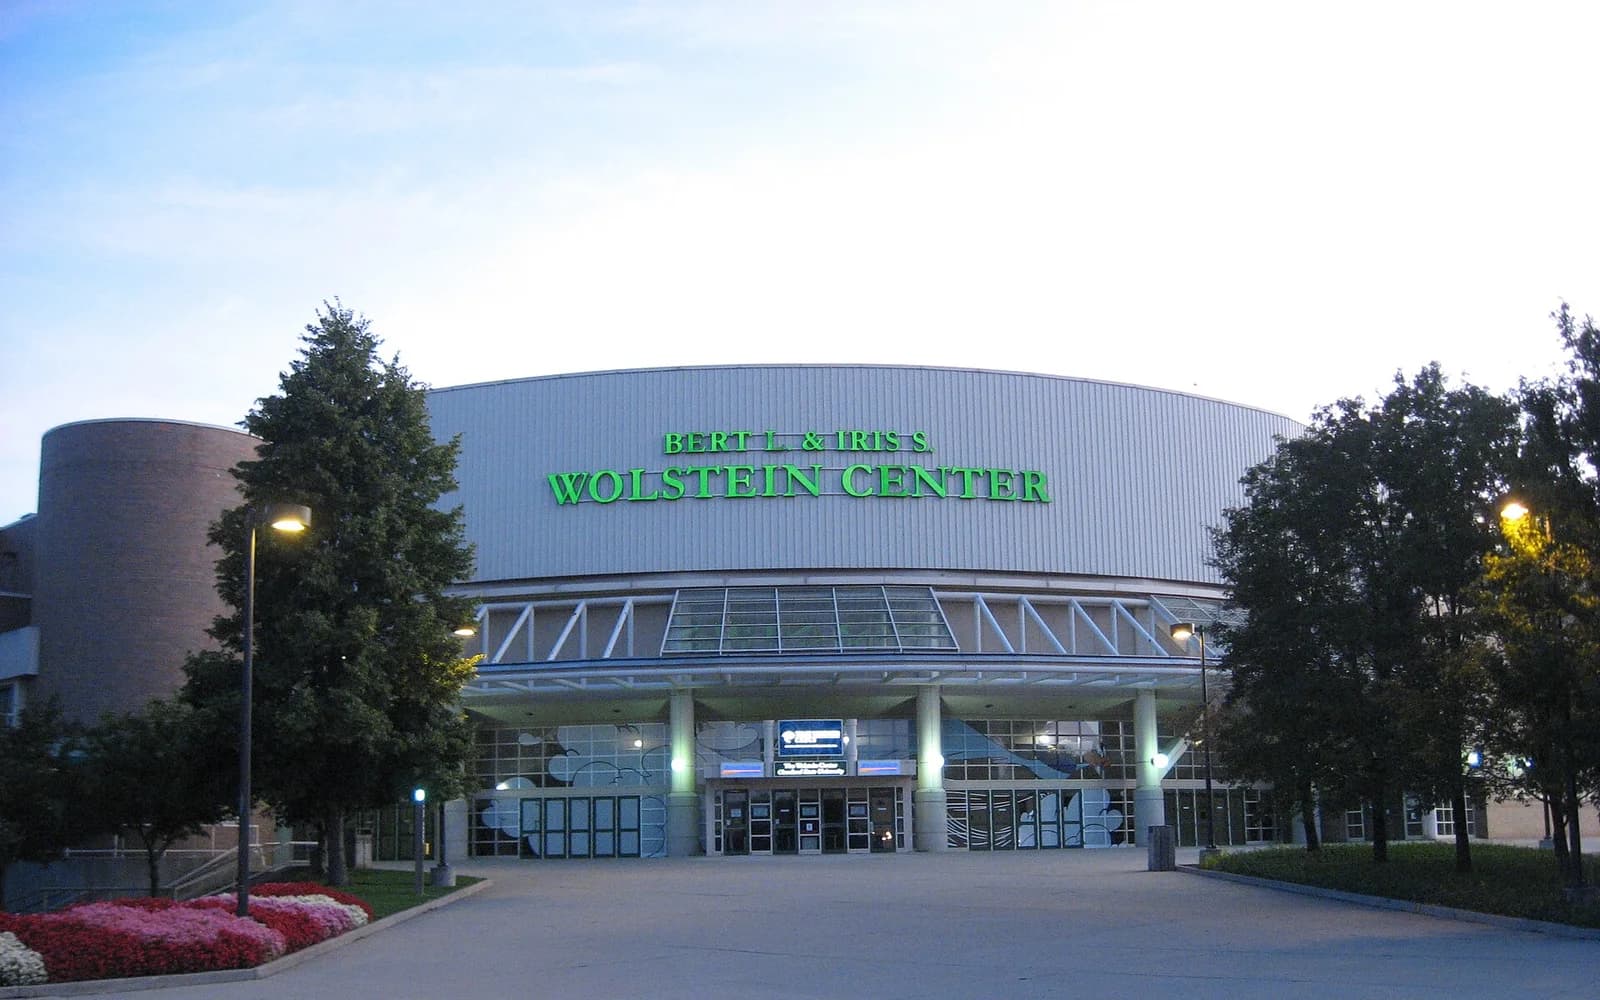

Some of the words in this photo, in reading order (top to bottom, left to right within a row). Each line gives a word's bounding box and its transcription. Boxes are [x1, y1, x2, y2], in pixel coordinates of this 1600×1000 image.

[664, 430, 753, 455] BERT
[764, 430, 789, 452] L.
[802, 430, 825, 452] &
[837, 429, 901, 453] IRIS
[912, 430, 934, 453] S.
[547, 463, 822, 505] WOLSTEIN
[841, 463, 1051, 503] CENTER
